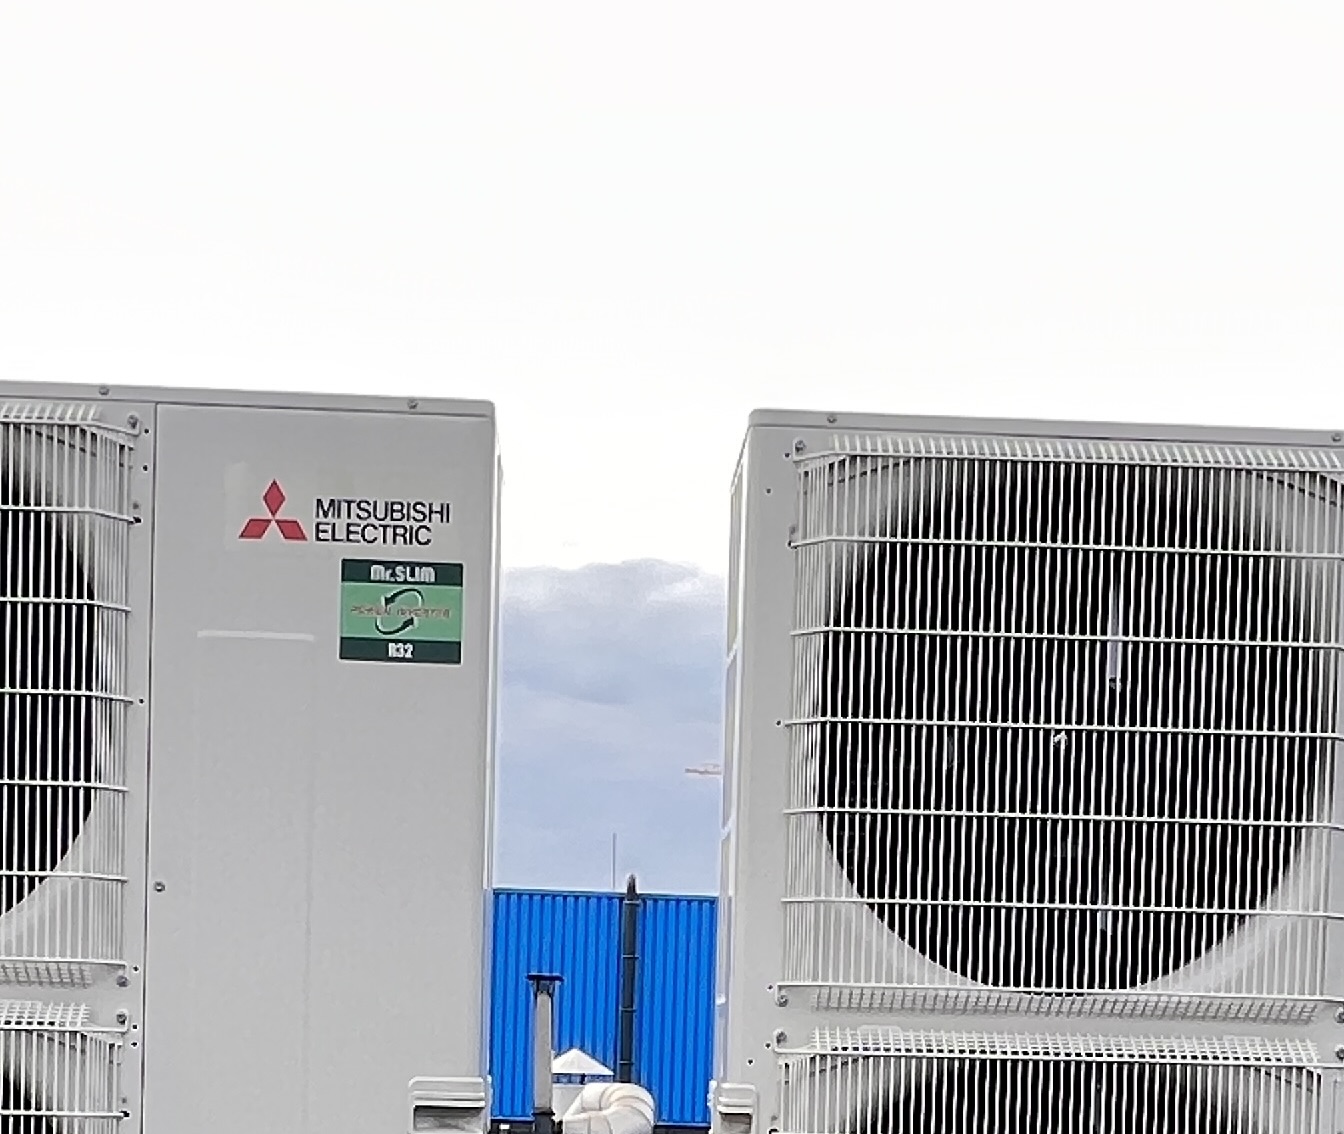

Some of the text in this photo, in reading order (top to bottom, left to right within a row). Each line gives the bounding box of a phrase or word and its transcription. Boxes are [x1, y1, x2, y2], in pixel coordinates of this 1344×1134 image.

[315, 499, 451, 523] MITSUBISHI
[314, 522, 432, 546] ELECTRIC
[388, 642, 414, 658] R32
